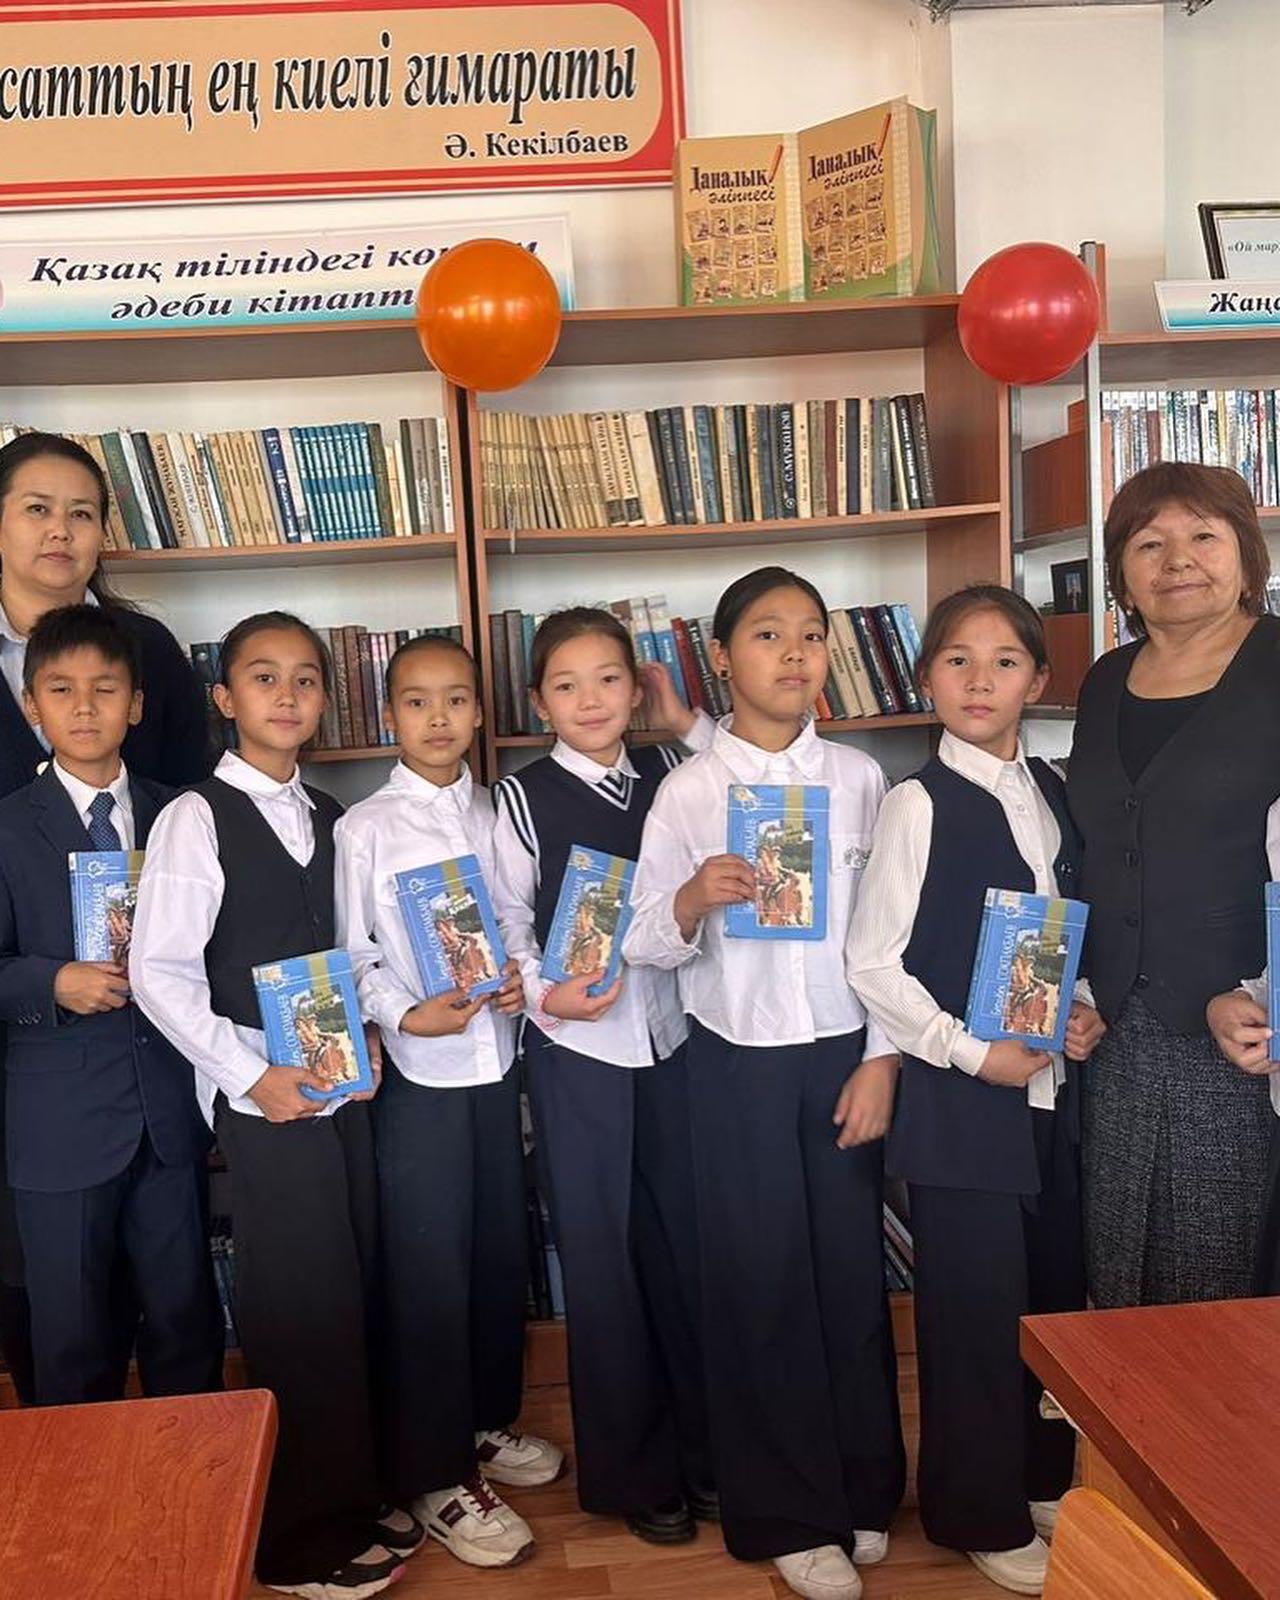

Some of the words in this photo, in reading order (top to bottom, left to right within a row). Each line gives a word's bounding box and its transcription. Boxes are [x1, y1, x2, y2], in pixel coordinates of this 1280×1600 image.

[209, 61, 258, 128] ең
[274, 32, 390, 110] киелі
[445, 134, 475, 158] Ә.
[486, 131, 629, 157] Кекілбаев
[30, 258, 163, 284] Қазақ
[175, 244, 375, 279] тіліндегі
[111, 289, 232, 320] әдеби
[249, 287, 414, 317] кітапт
